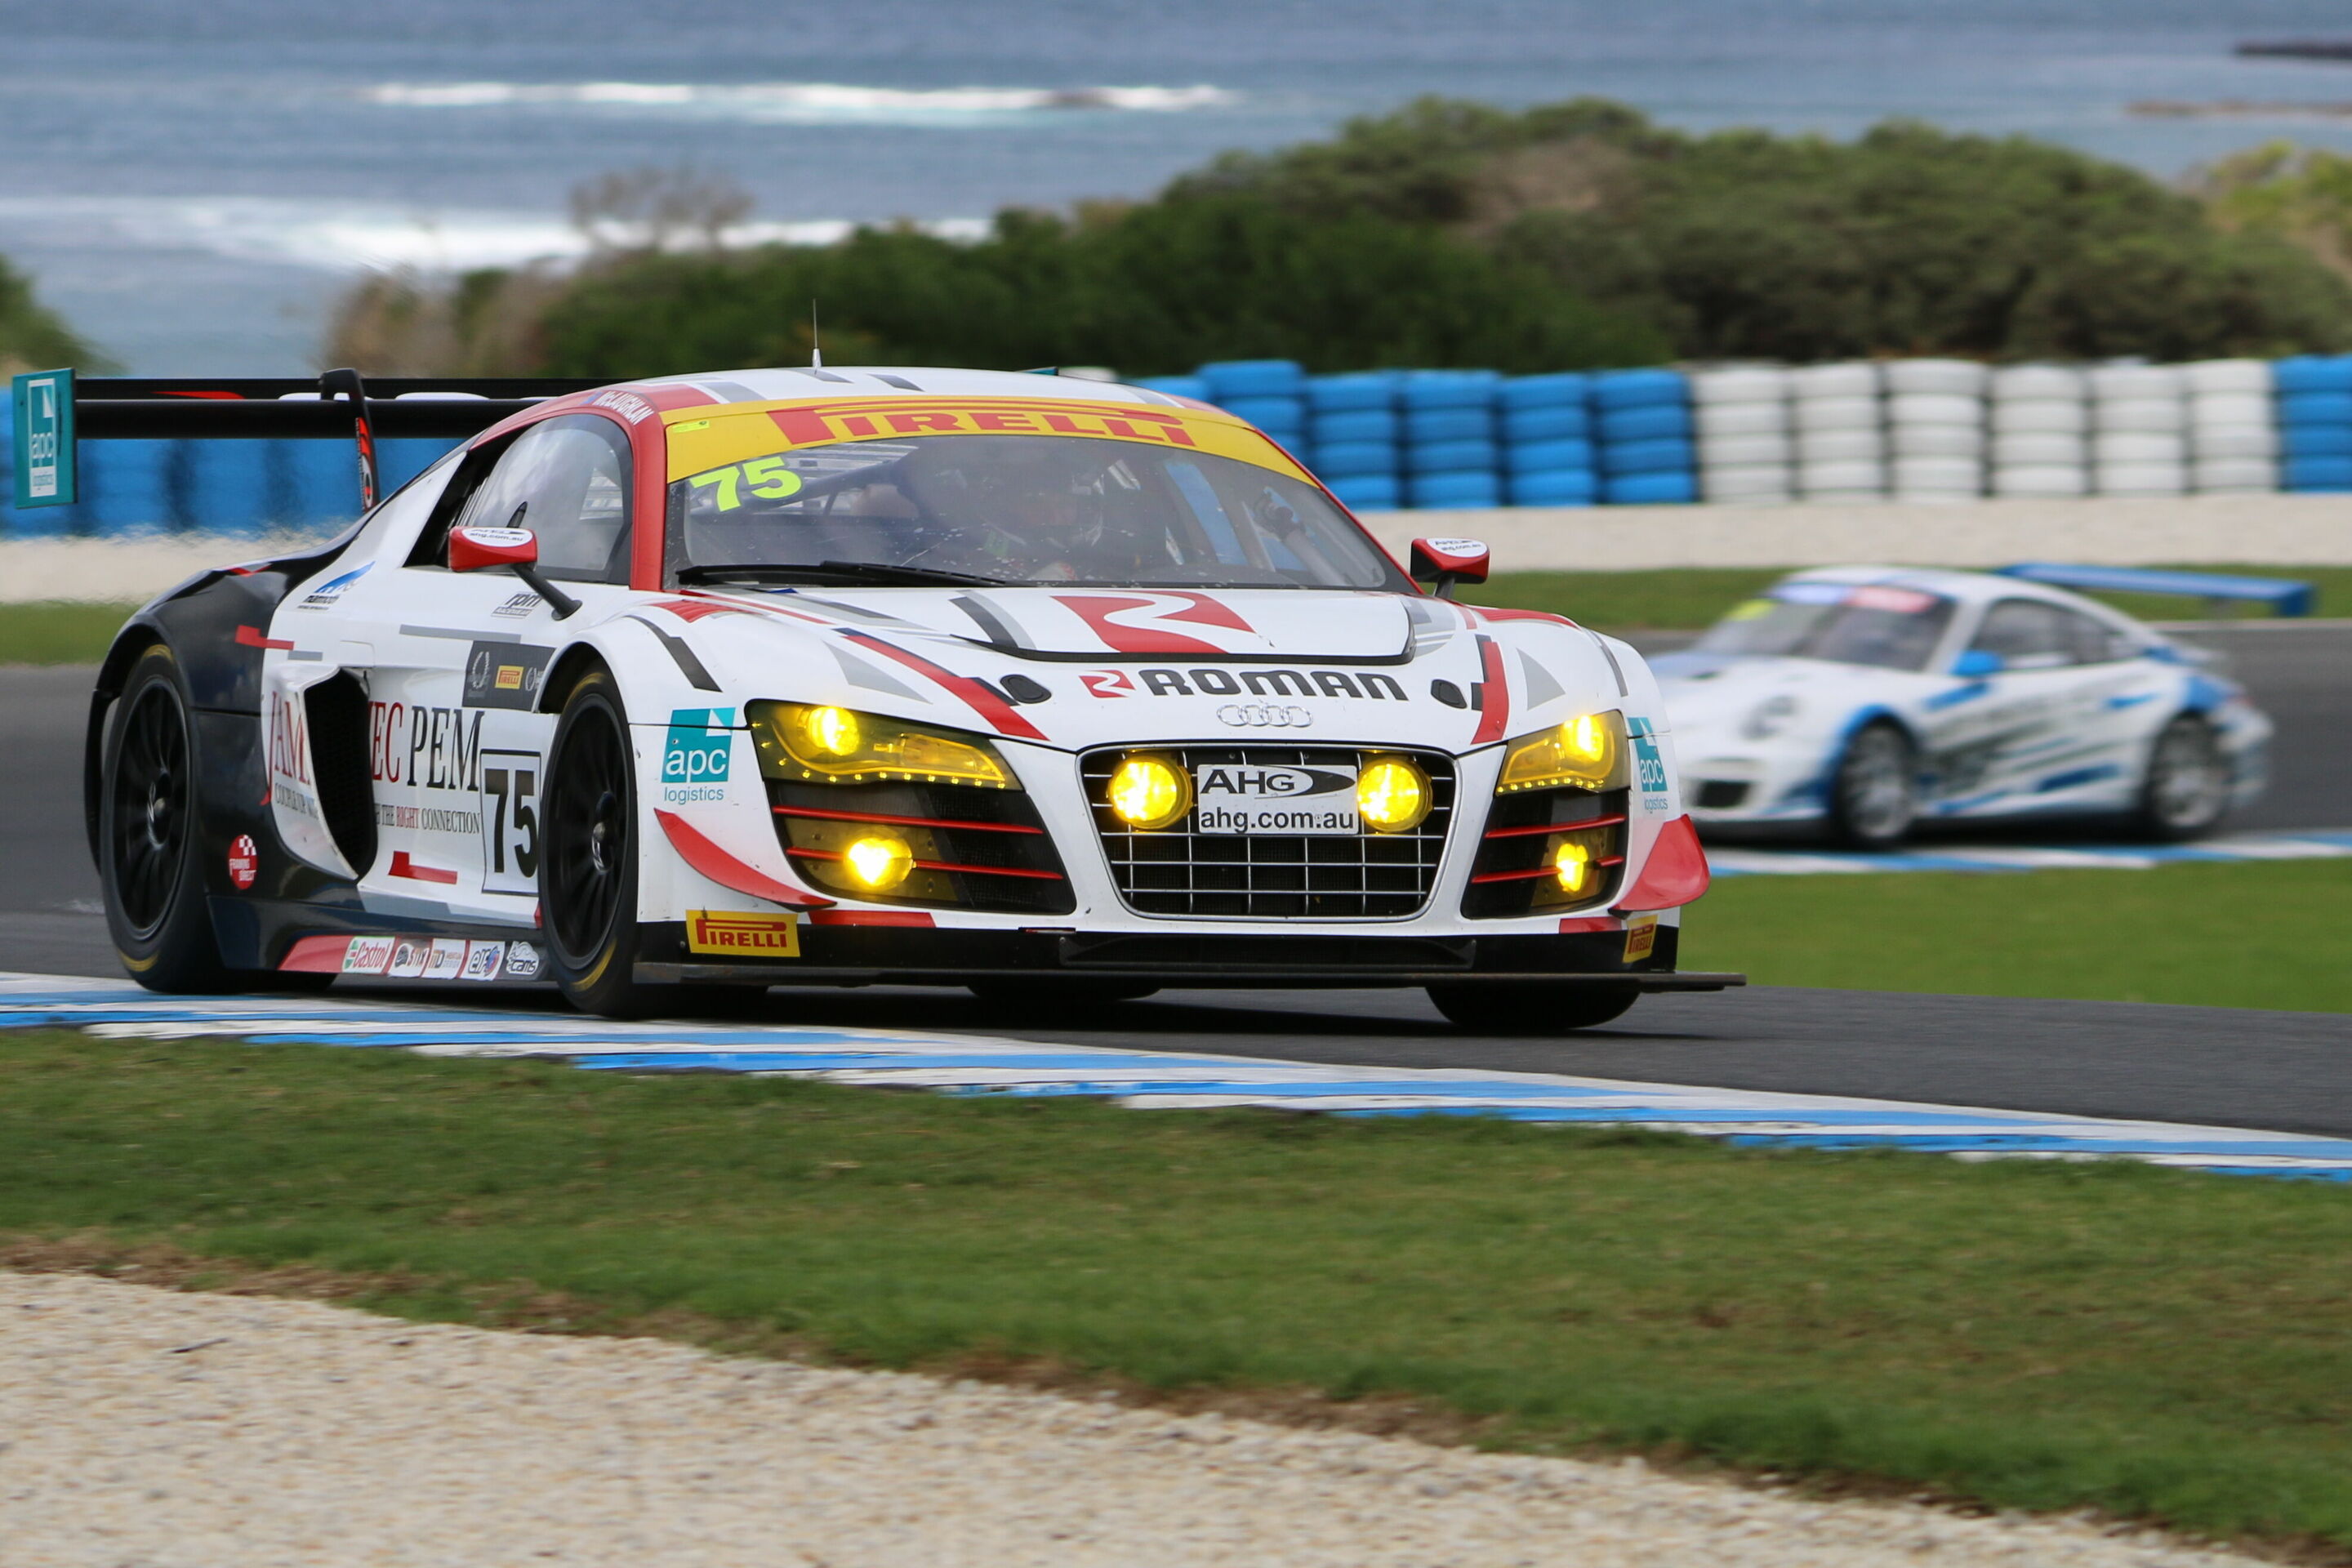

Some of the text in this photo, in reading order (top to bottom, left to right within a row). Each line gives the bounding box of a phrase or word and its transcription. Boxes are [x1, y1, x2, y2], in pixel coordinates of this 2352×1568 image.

[767, 399, 1196, 446] PIRELLI
[689, 457, 802, 512] 75
[1138, 668, 1410, 701] ROMAN
[407, 706, 485, 791] PEM
[665, 747, 728, 783] apc
[1640, 759, 1663, 793] apc
[664, 786, 724, 804] logistics
[1200, 768, 1296, 795] AHG
[381, 804, 395, 826] THE
[396, 806, 419, 829] RIGHT
[421, 808, 480, 834] CONNECTION
[1200, 807, 1354, 833] ahg.com.au
[1644, 797, 1668, 814] logistics
[484, 768, 539, 878] 75
[696, 919, 787, 947] PIRELLI
[1628, 923, 1654, 954] PIRELLI
[353, 942, 390, 968] Castrol
[510, 959, 537, 973] cams
